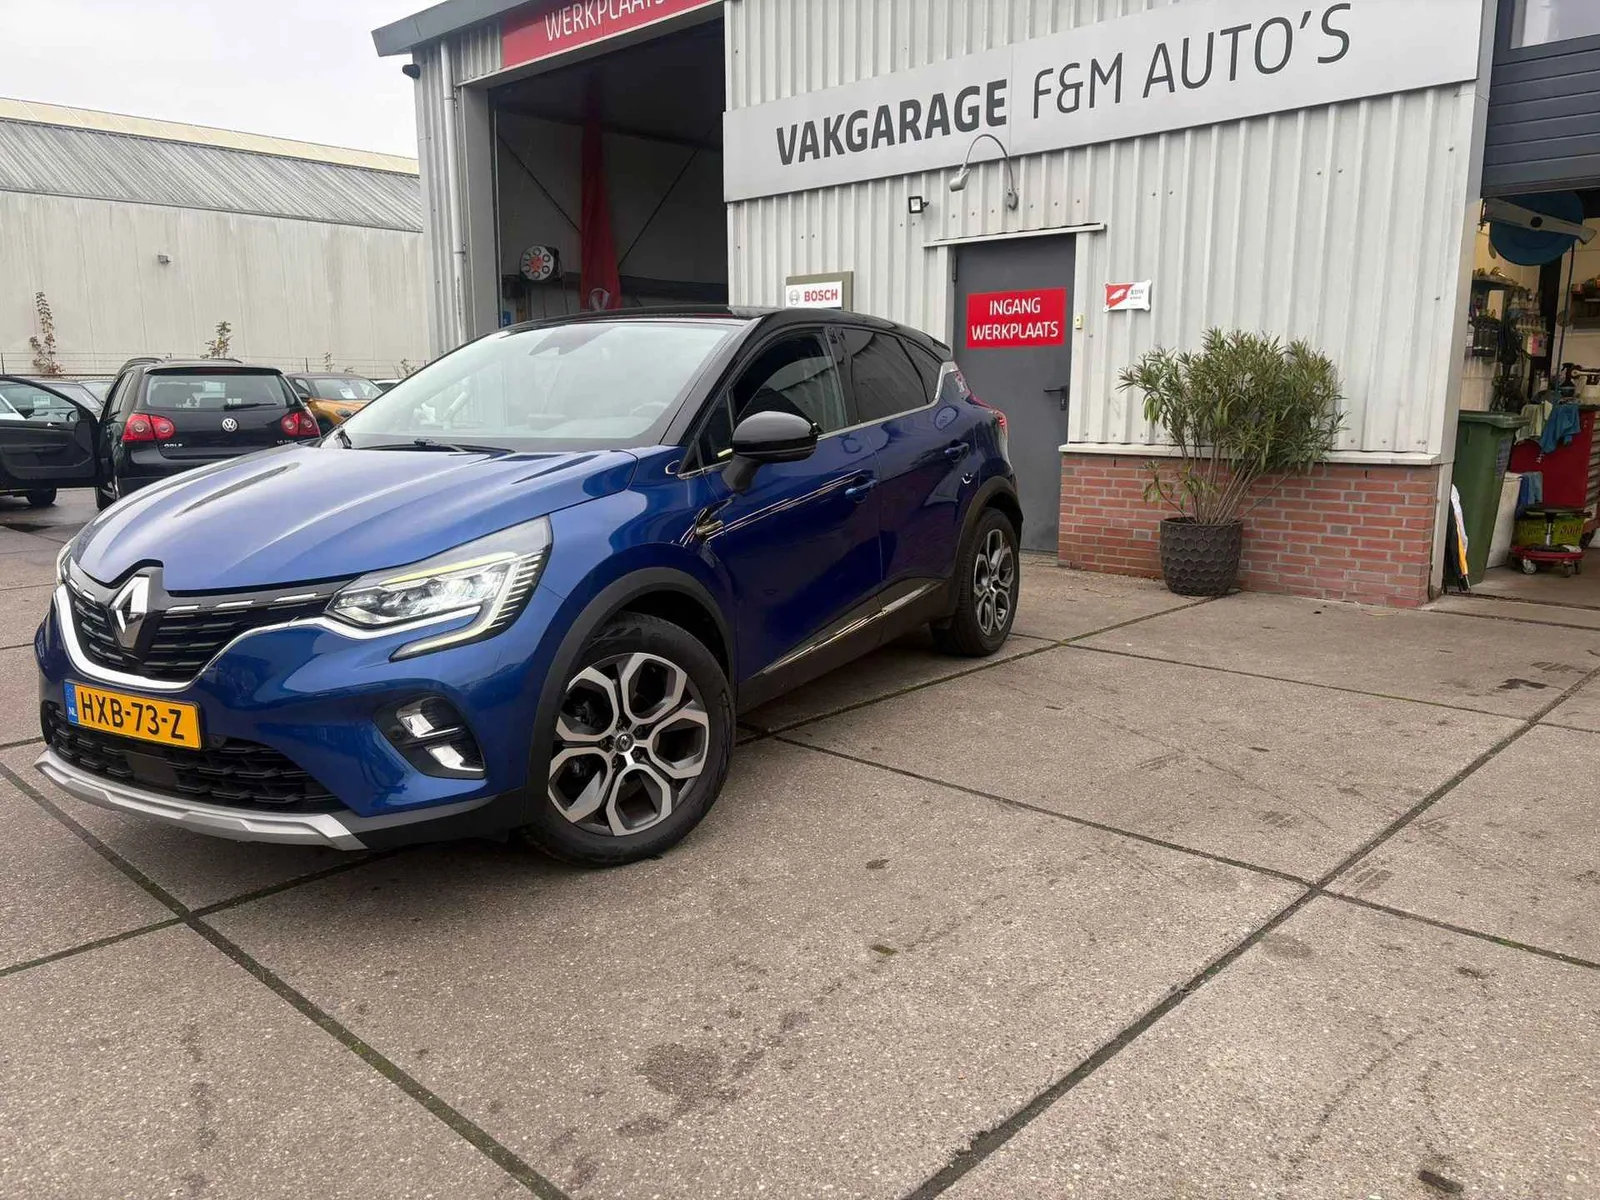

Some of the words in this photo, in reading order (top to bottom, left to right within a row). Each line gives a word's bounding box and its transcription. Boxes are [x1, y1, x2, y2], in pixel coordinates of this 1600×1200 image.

[776, 78, 1008, 166] VAKGARAGE
[1033, 52, 1123, 119] F&M
[804, 289, 838, 302] BOSCH
[989, 297, 1041, 316] INGANG
[971, 321, 1059, 341] WERKPLAATS
[80, 691, 184, 740] HXB-73-Z
